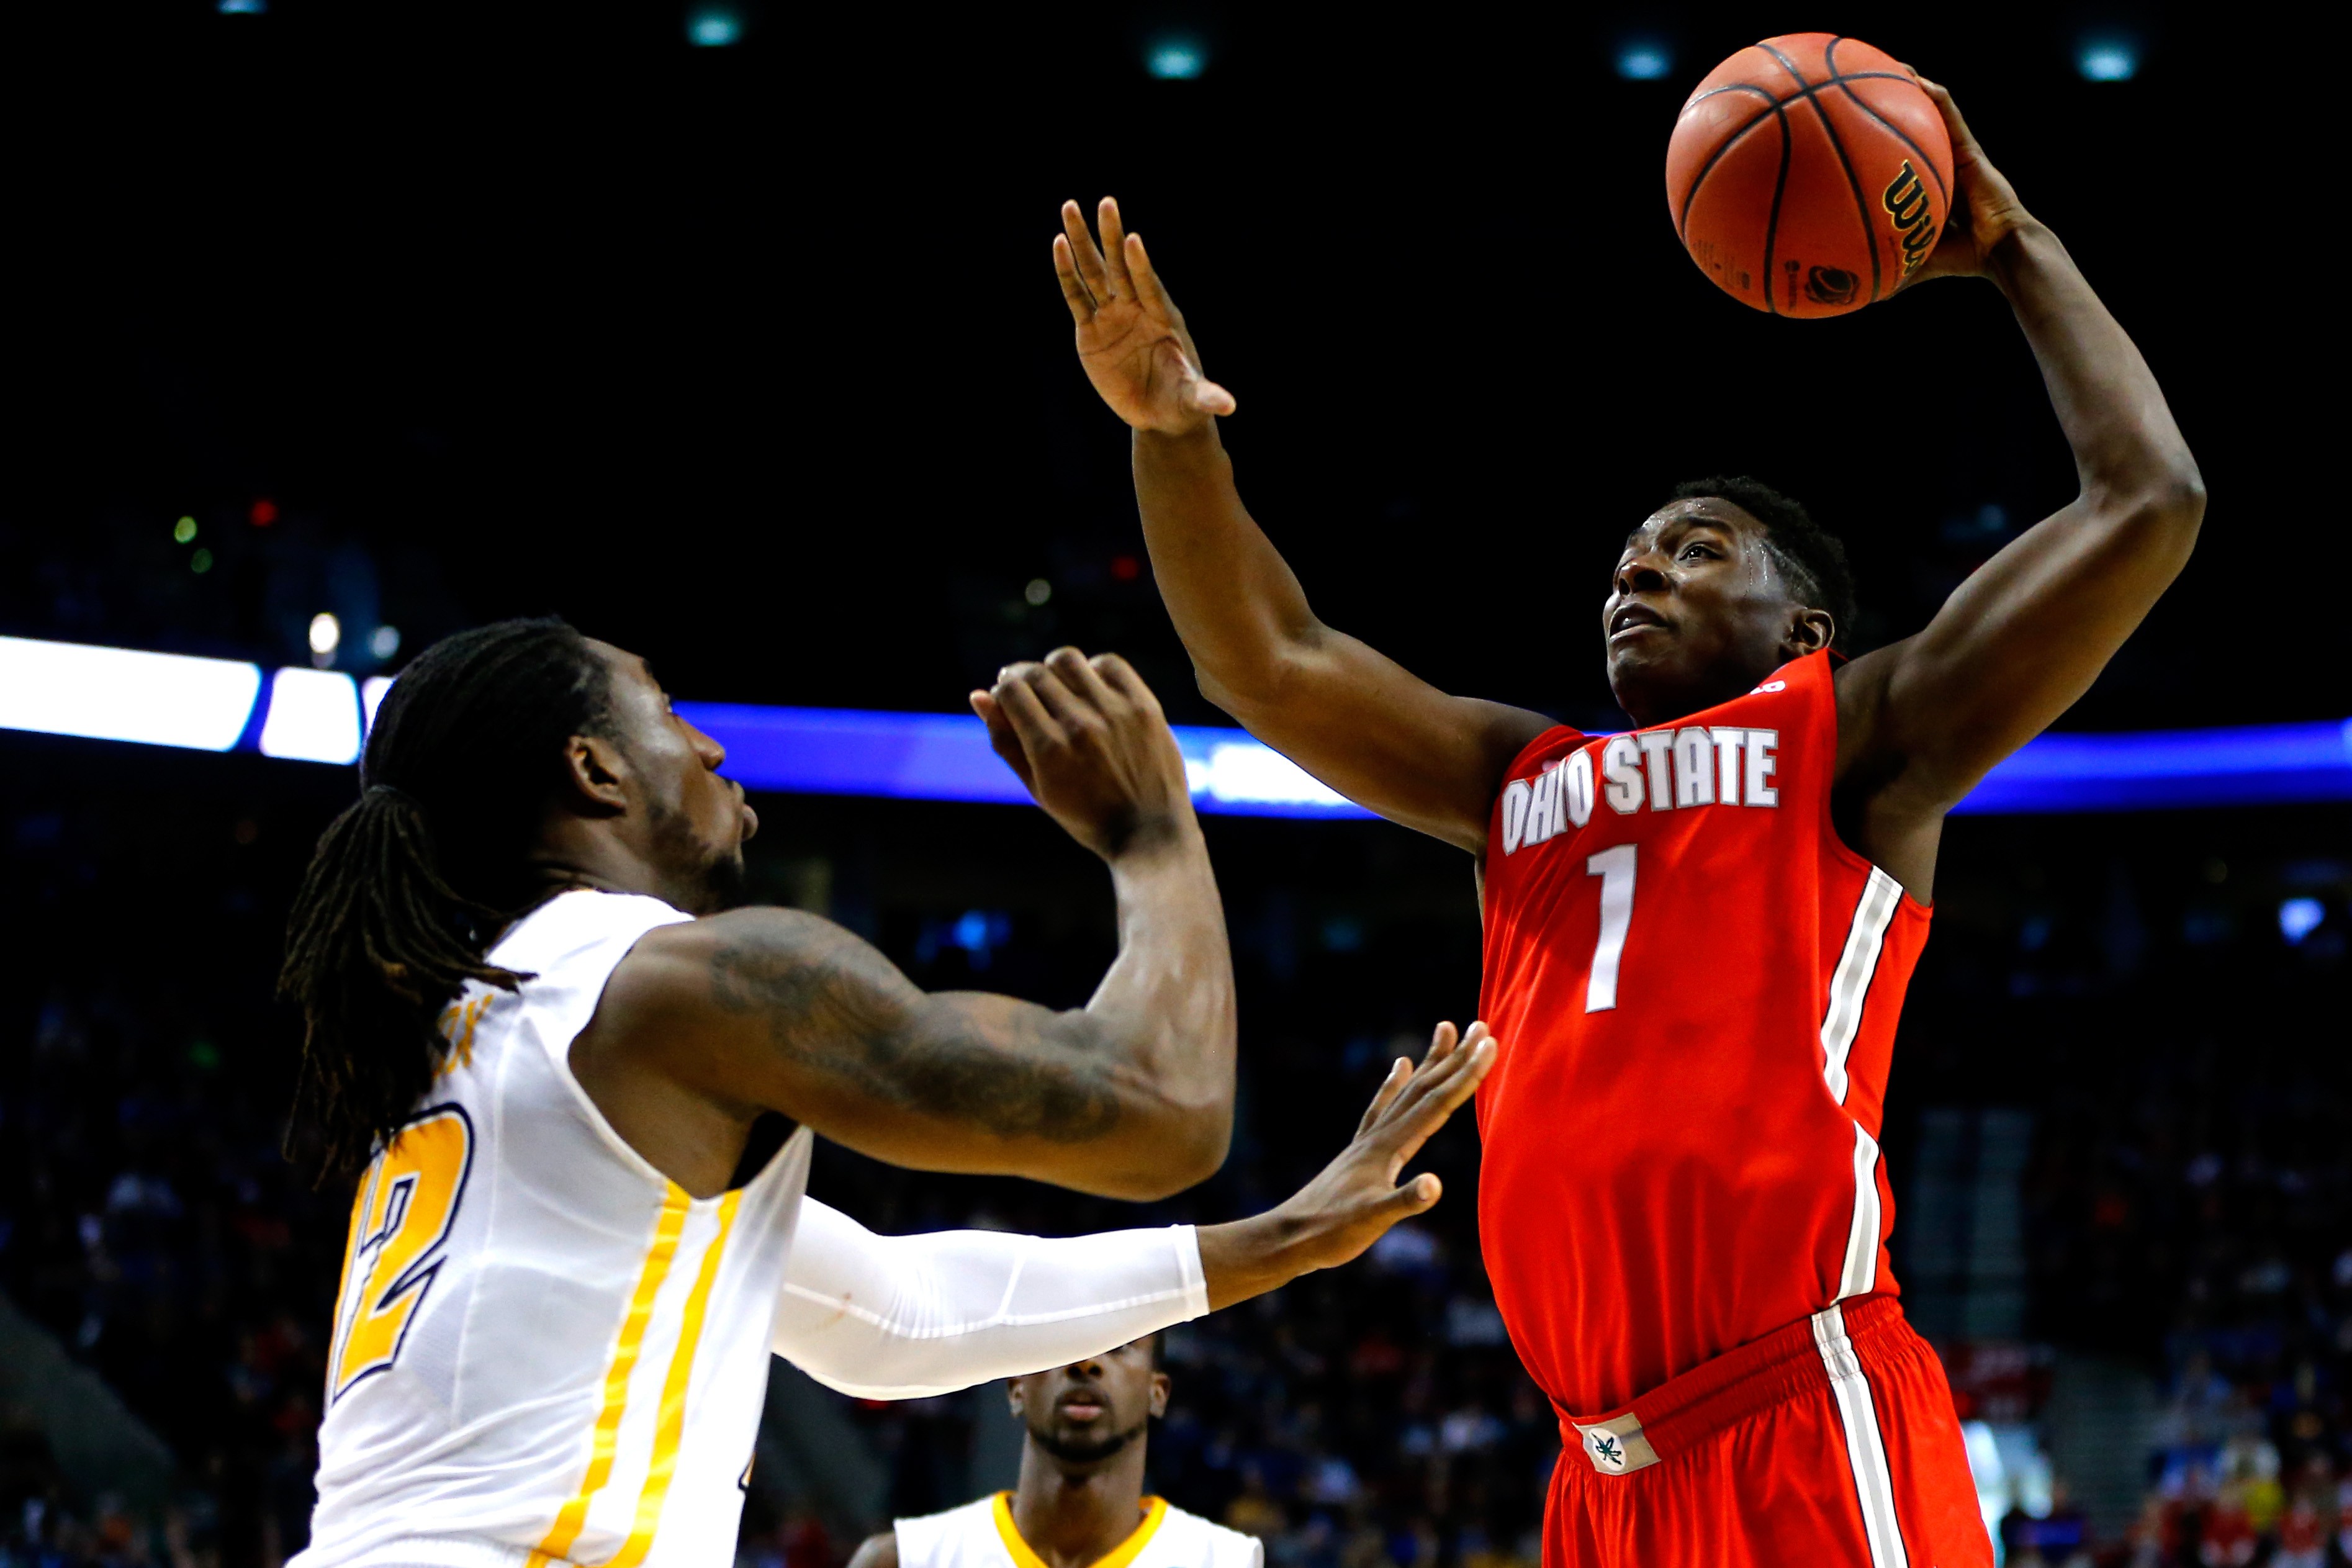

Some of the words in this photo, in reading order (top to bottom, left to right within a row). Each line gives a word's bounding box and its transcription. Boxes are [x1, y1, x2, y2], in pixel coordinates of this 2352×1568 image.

[1501, 747, 1595, 857] OHIO
[1602, 725, 1779, 815] STATE
[1585, 843, 1638, 1014] 1
